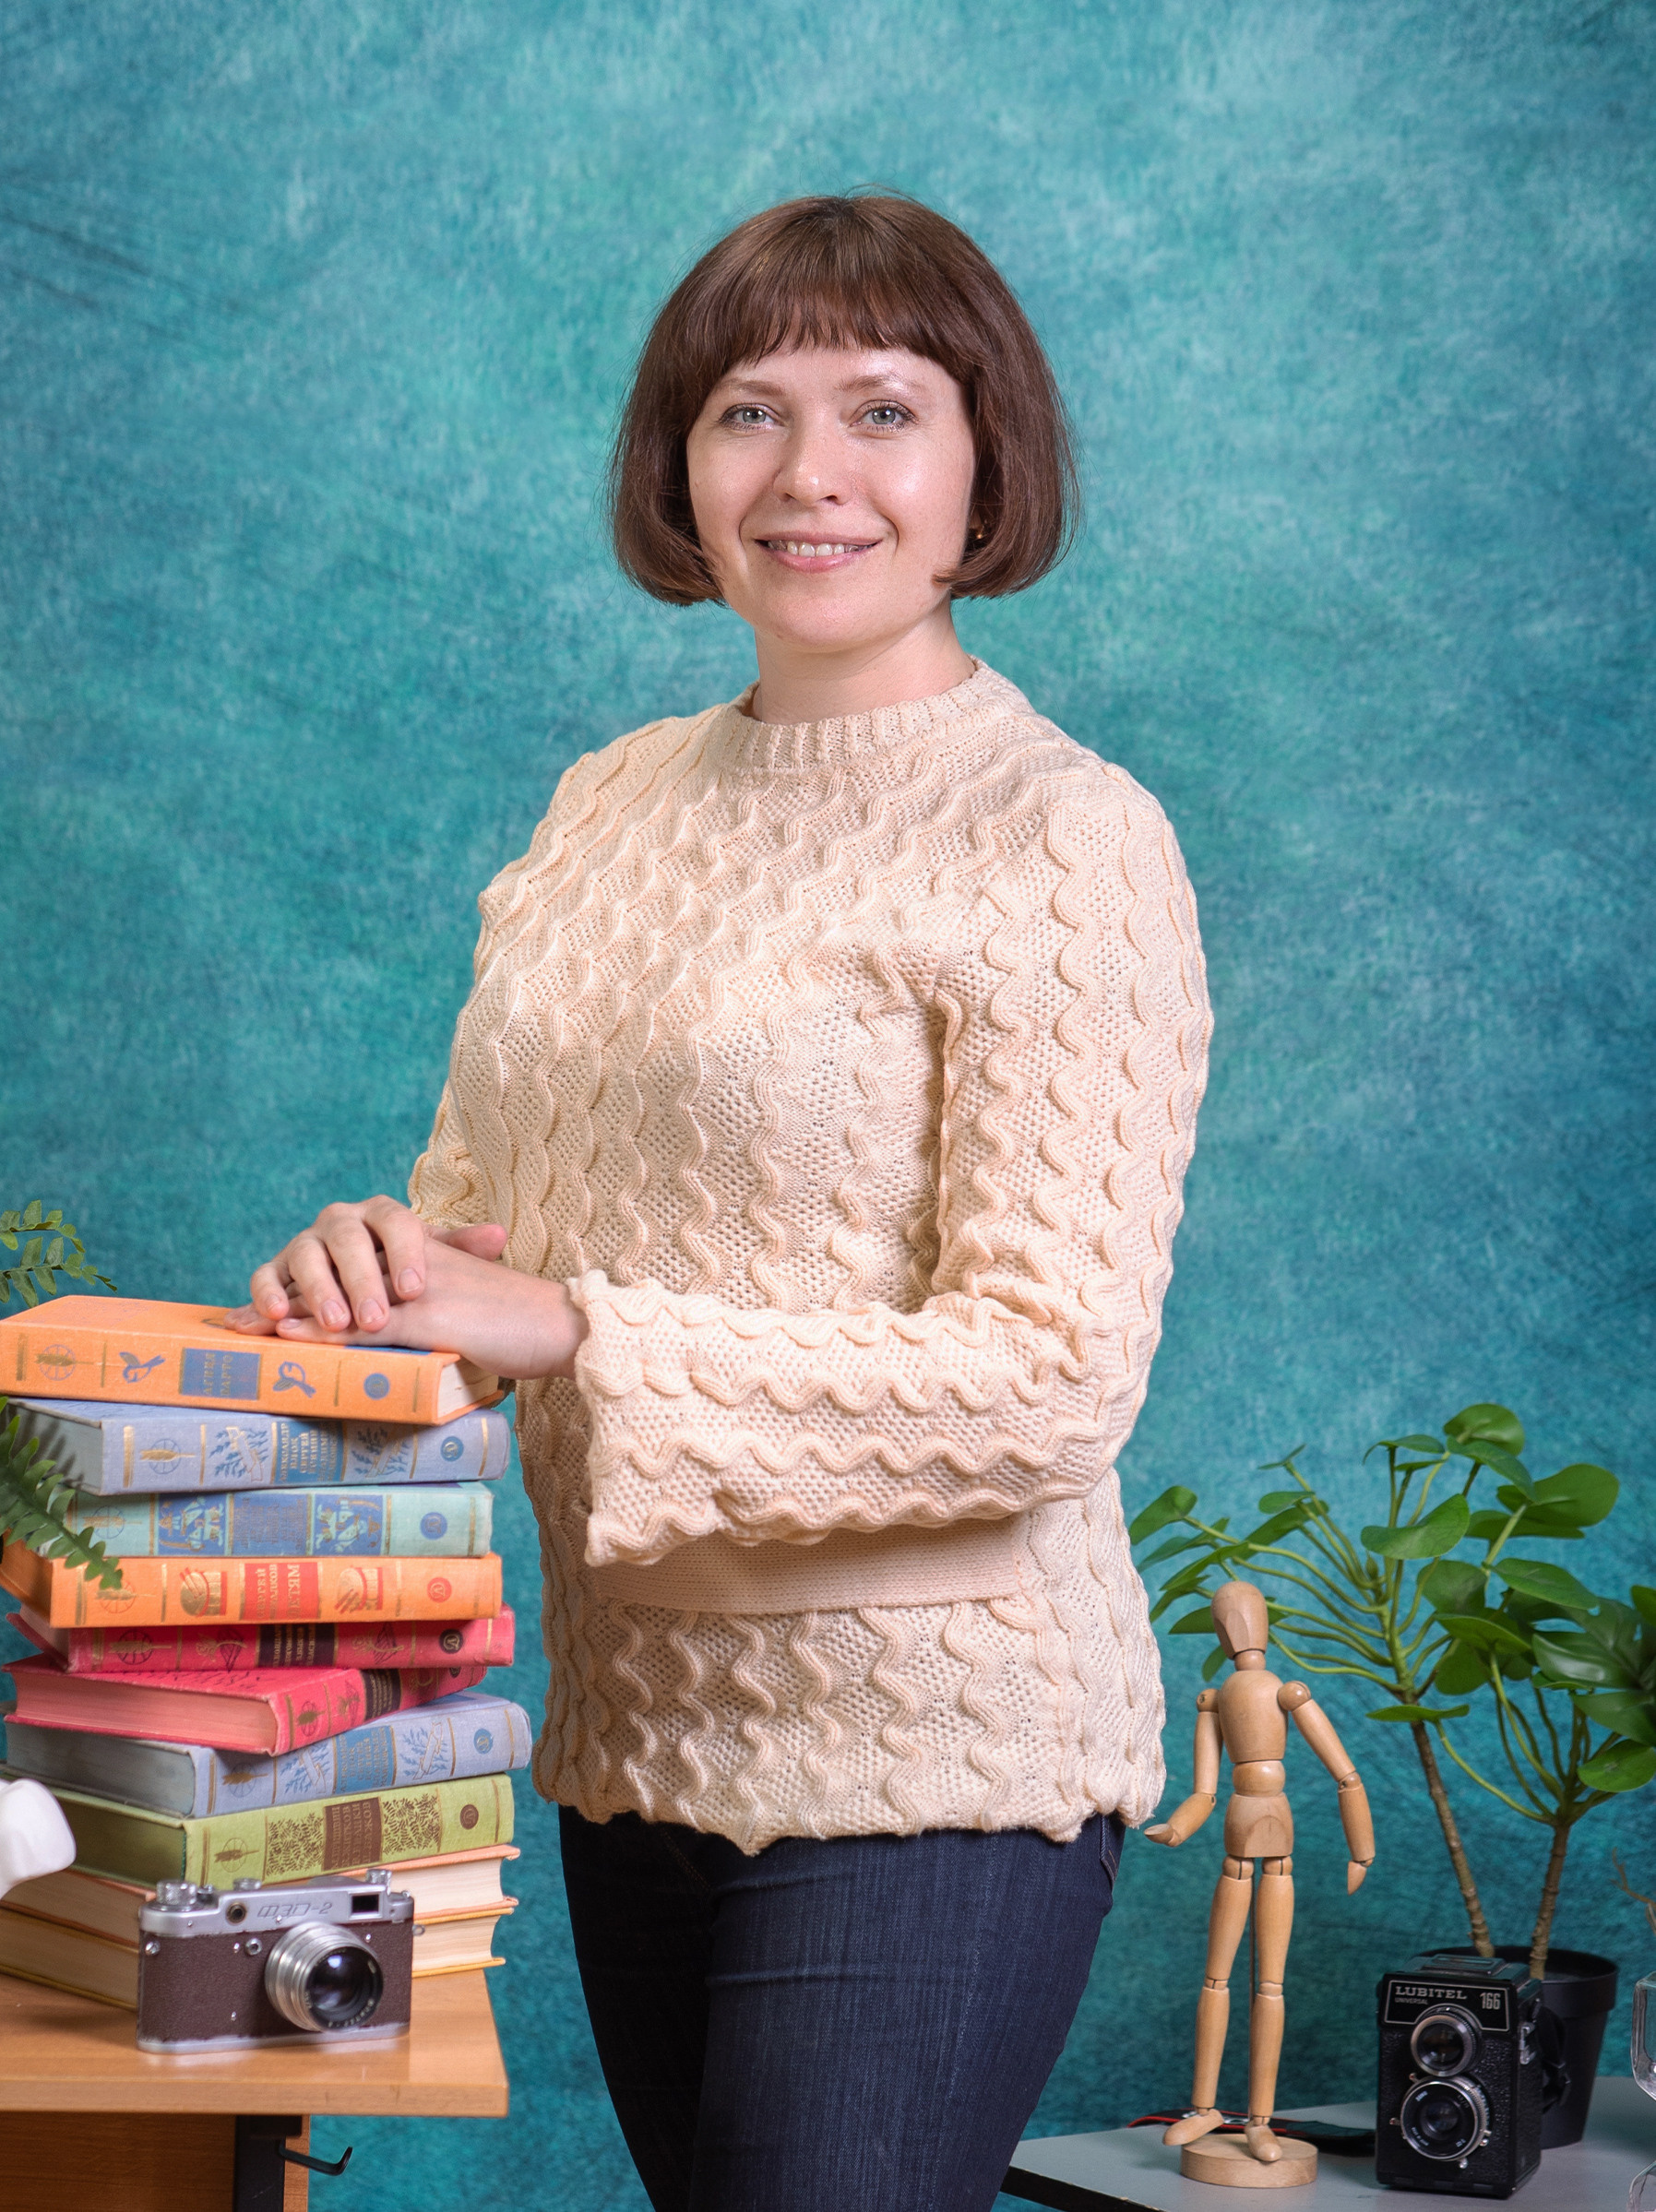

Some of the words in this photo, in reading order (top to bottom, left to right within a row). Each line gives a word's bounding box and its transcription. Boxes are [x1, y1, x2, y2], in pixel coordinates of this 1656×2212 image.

[220, 1354, 233, 1397] БАРТО
[279, 1422, 290, 1481] АЛЕКСАНДР
[290, 1437, 299, 1469] БЛОК
[299, 1433, 308, 1473] СЕРГЕЙ
[256, 1568, 266, 1618] СЕРГЕЙ
[1394, 1997, 1428, 2005] UNIVERSAL
[1395, 1986, 1468, 2000] LUBITEL
[1480, 1992, 1501, 2010] 166
